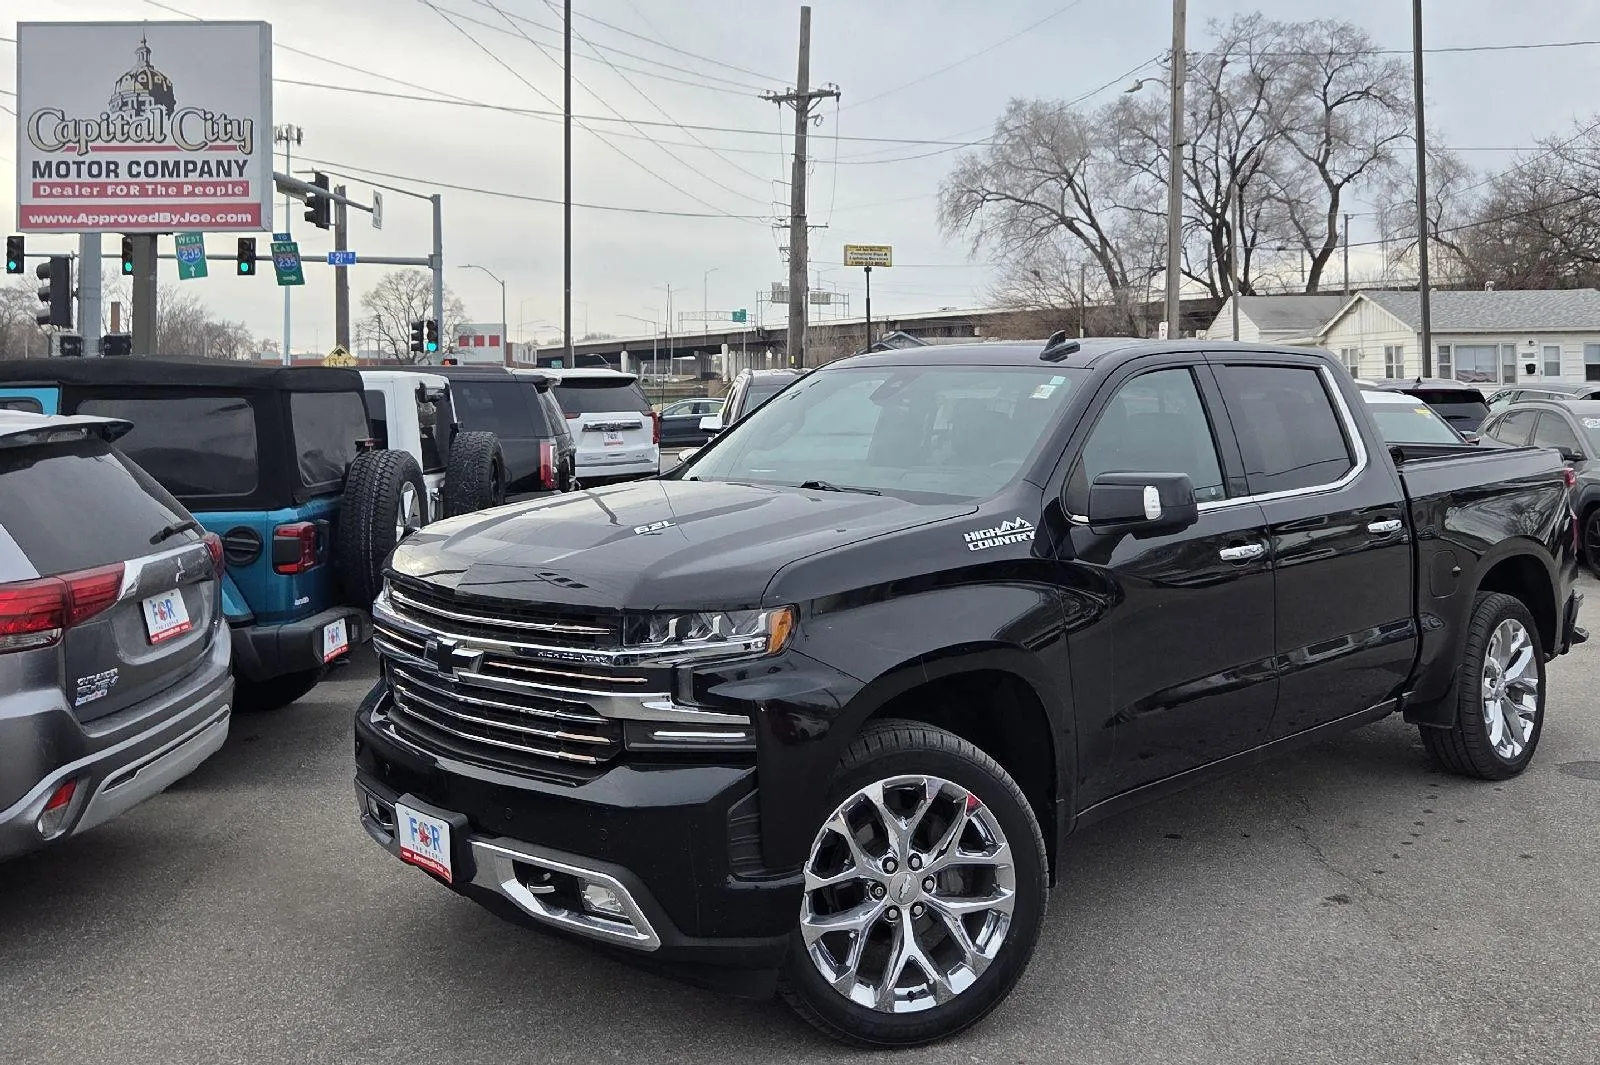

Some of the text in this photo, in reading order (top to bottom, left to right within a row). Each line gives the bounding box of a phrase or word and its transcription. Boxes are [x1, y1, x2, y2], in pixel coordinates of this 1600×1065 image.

[27, 107, 253, 155] Capital City
[32, 159, 248, 179] MOTOR COMPANY
[40, 183, 243, 196] Dealer FOR The People
[28, 211, 252, 226] www.ApprovedByJoe.com
[178, 235, 200, 244] WEST
[182, 249, 200, 259] 235
[273, 244, 294, 252] EAST
[279, 257, 297, 267] 235
[964, 527, 1001, 542] HIGH
[968, 530, 1035, 551] COUNTRY
[408, 816, 442, 853] FOR
